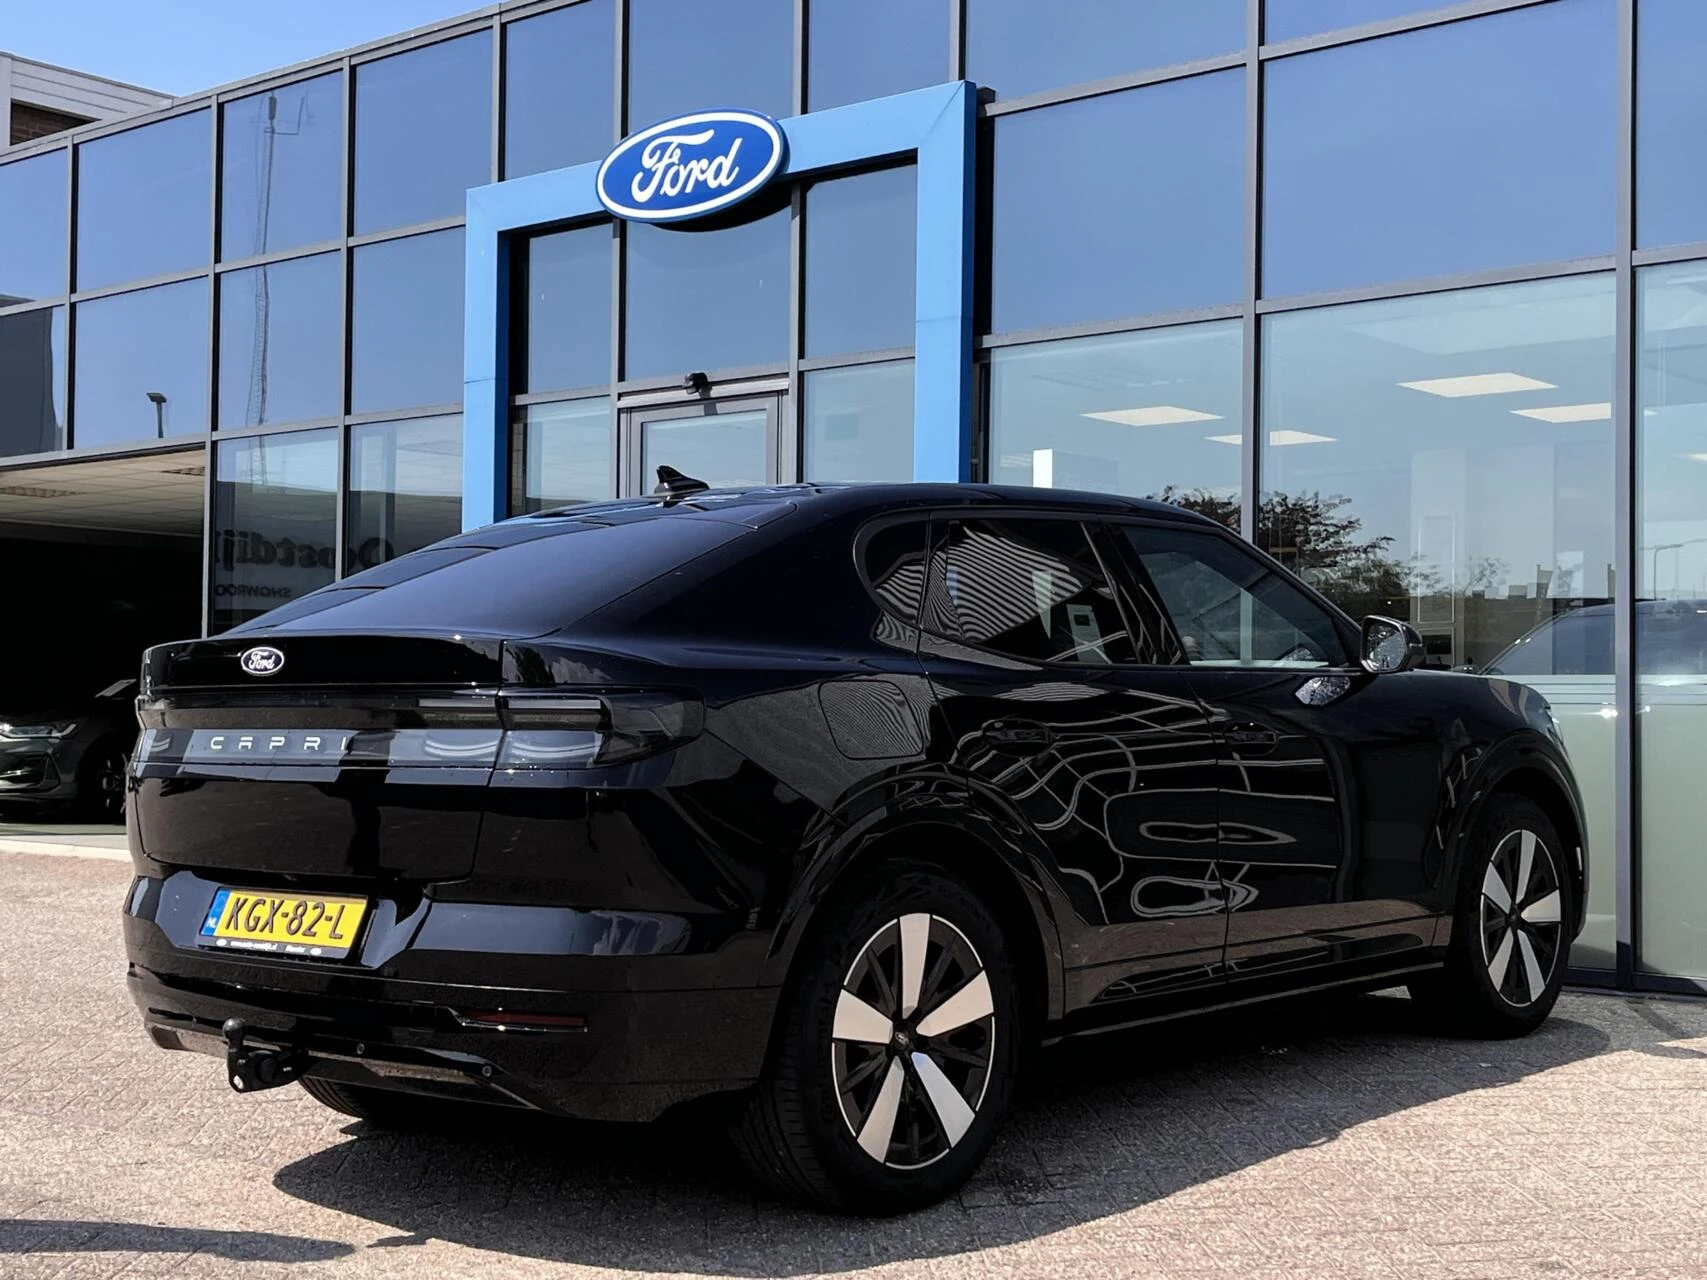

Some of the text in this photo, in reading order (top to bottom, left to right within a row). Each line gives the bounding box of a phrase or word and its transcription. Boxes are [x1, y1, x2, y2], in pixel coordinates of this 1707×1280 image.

[631, 129, 743, 203] Ford
[249, 651, 275, 670] Ford
[210, 736, 347, 750] CAPRI
[225, 897, 345, 939] KGX-82-L
